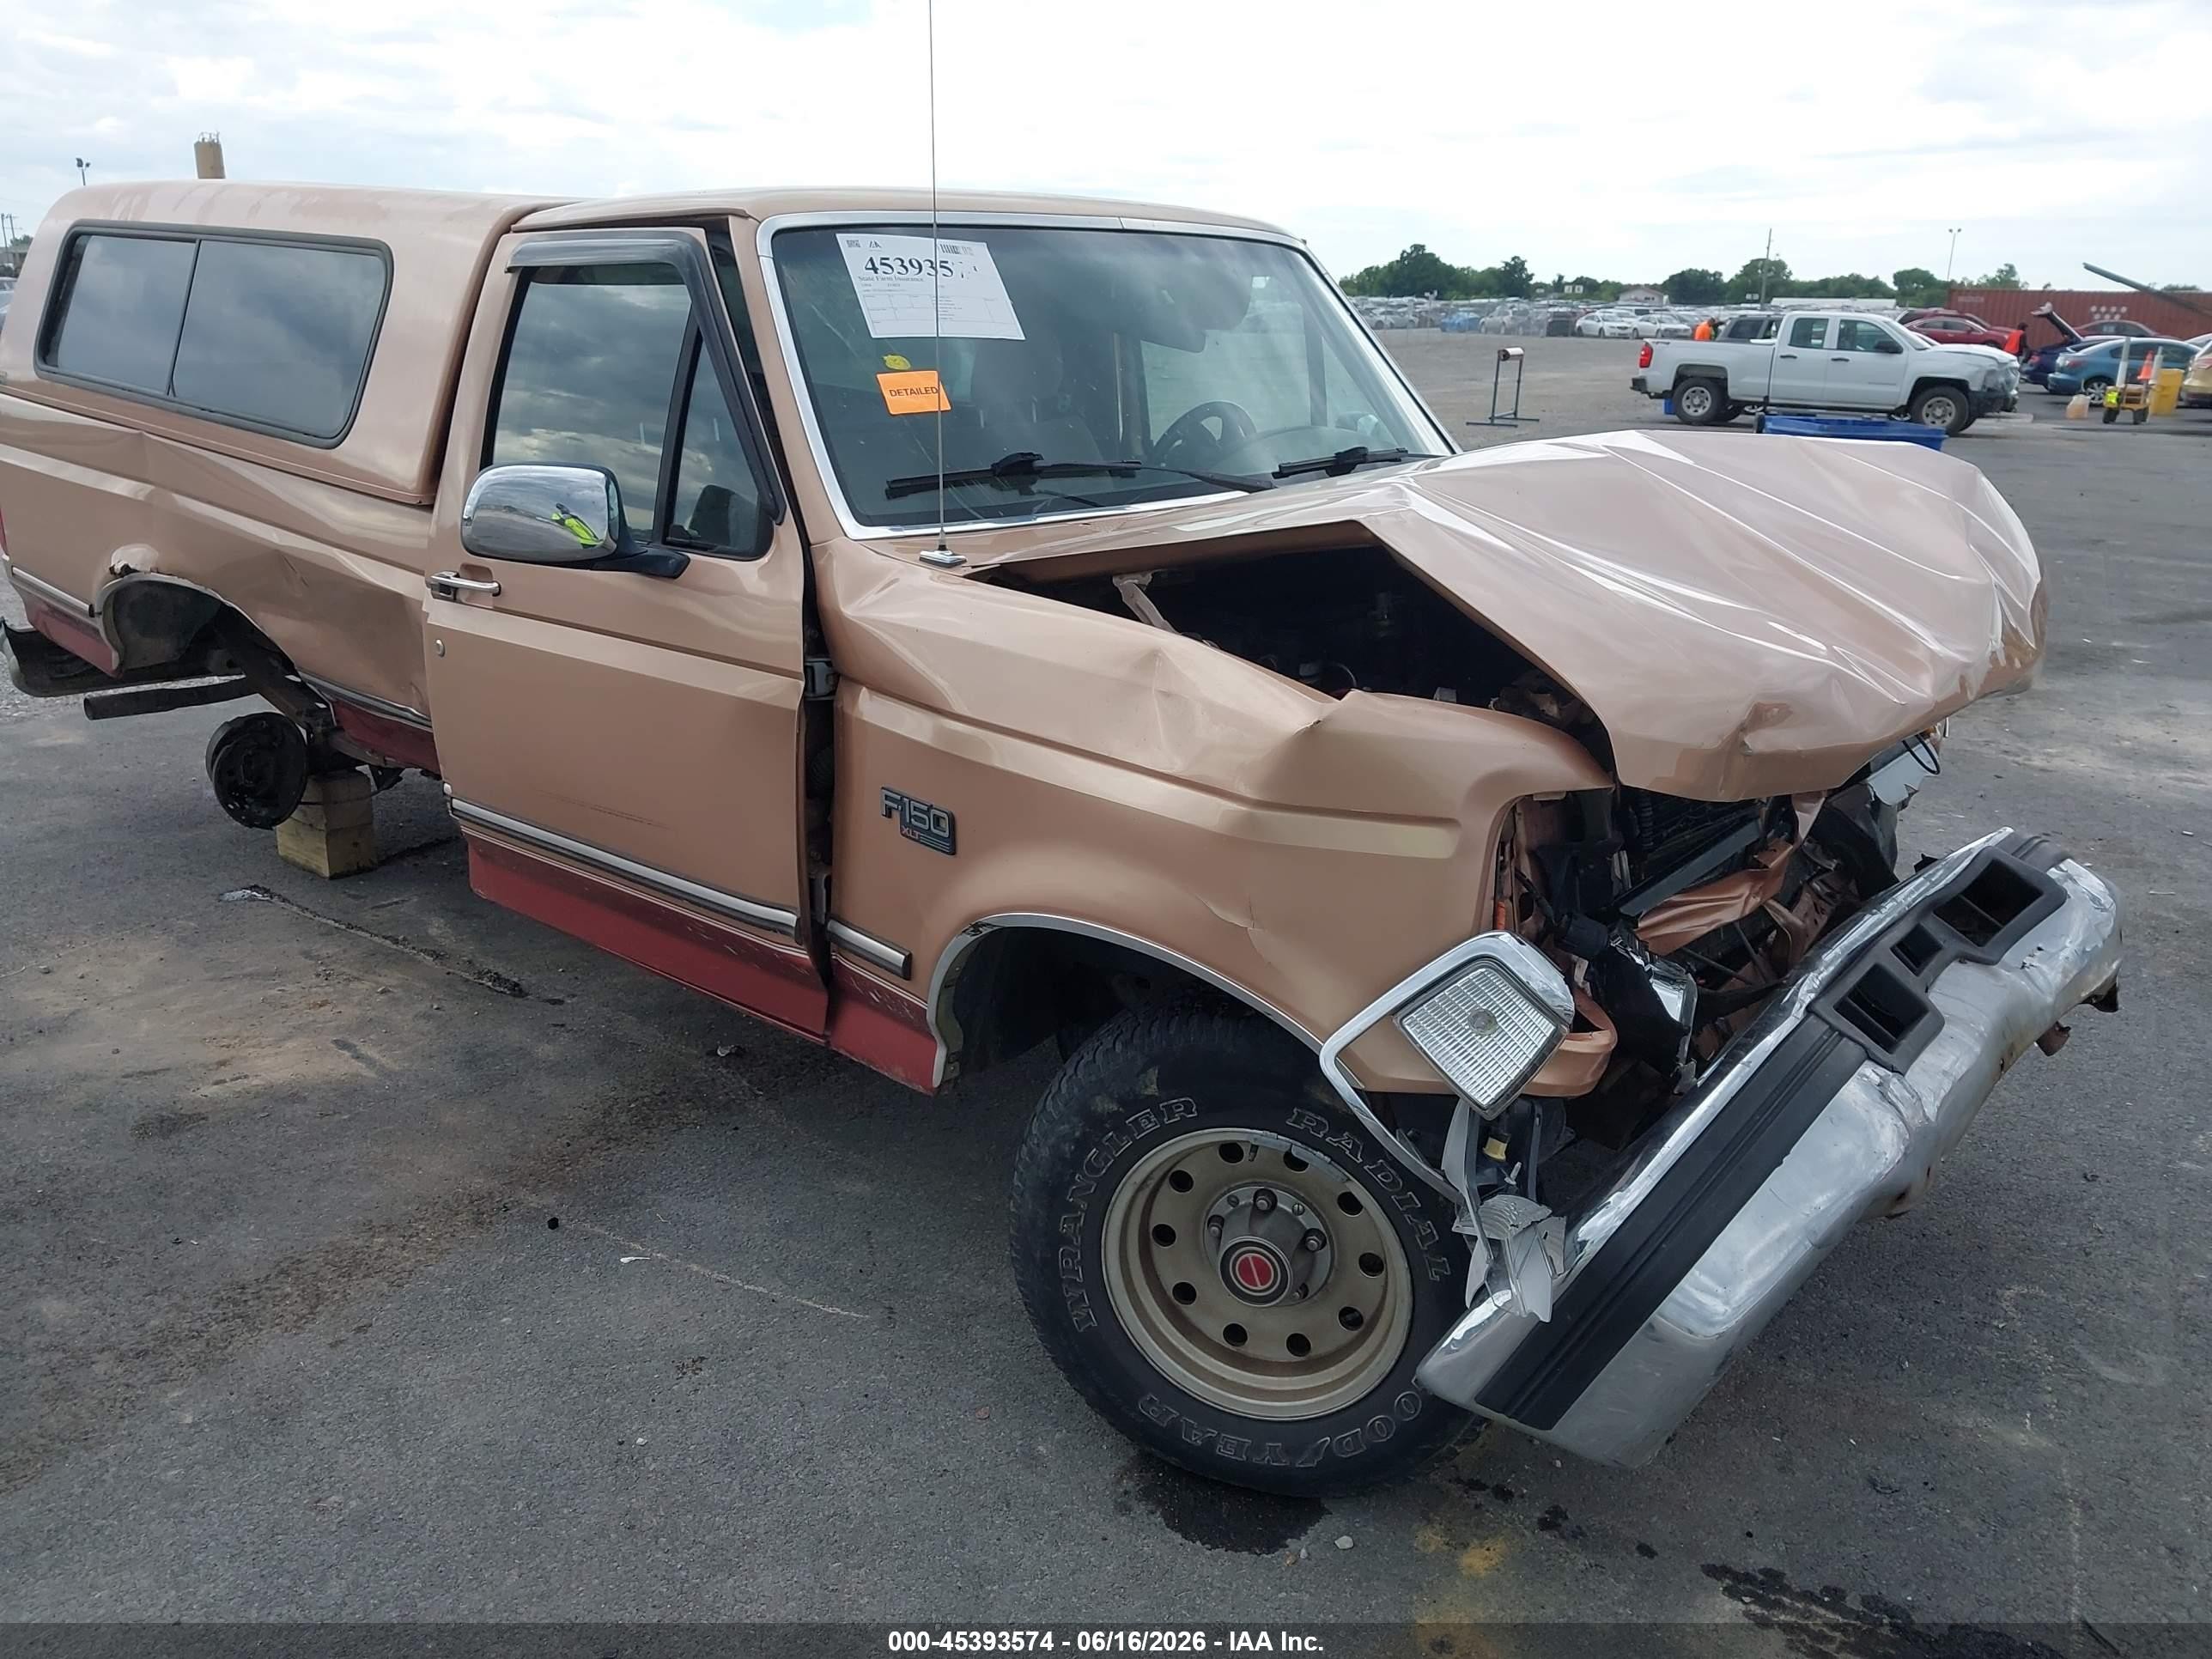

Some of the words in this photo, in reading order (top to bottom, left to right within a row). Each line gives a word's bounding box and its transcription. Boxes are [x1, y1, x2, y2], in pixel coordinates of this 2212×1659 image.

[864, 256, 979, 279] 453935
[889, 386, 939, 398] DETAILED
[901, 826, 921, 841] XLT
[1058, 1097, 1198, 1333] WRANGLER
[1285, 1107, 1453, 1281] RADIAL
[1139, 1374, 1427, 1468] OODYEAR
